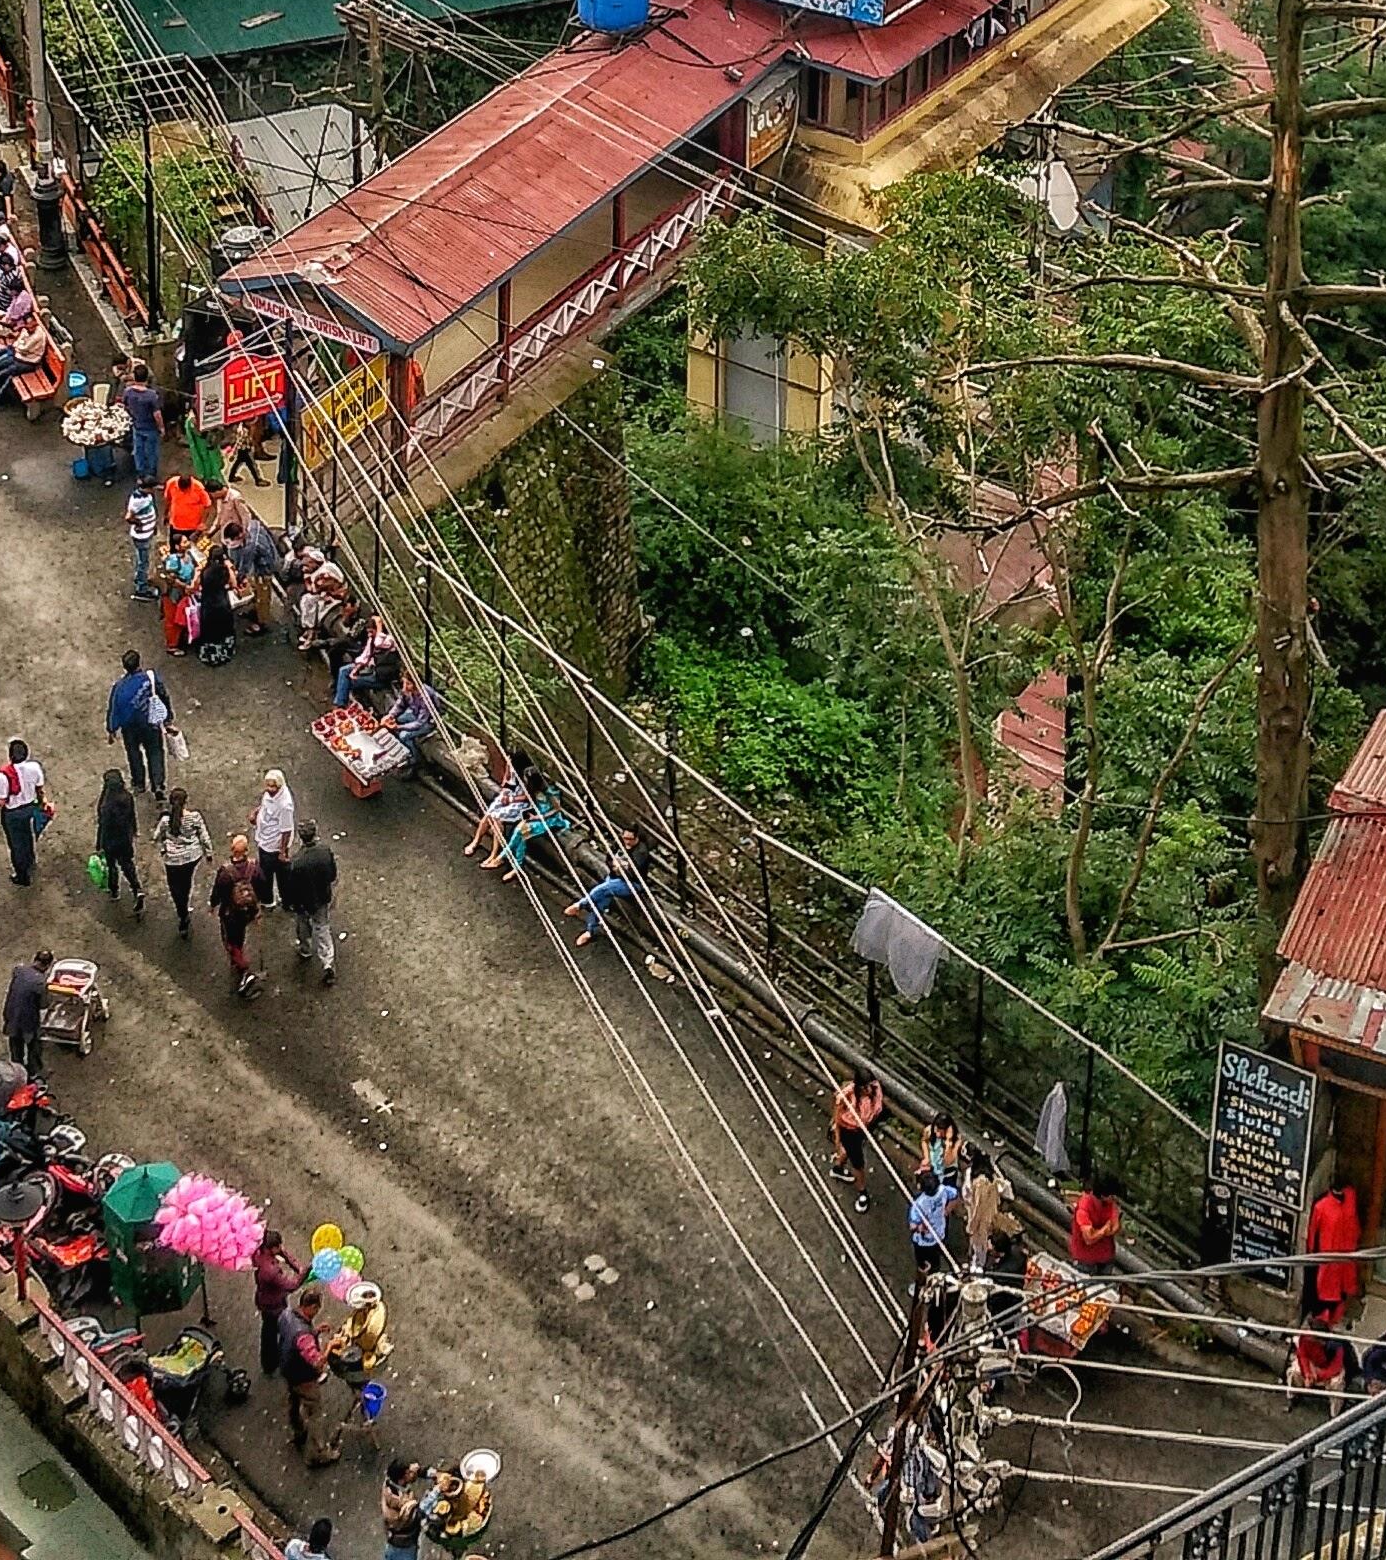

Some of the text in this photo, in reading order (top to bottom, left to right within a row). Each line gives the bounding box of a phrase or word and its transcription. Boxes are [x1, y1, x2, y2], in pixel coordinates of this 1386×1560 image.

[353, 333, 373, 349] LIFT
[229, 368, 281, 405] LIFT
[1221, 1052, 1311, 1110] Shehzadi
[1229, 1095, 1287, 1126] Shawls
[1215, 1129, 1292, 1166] Materials
[1229, 1148, 1283, 1176] Salwar
[1219, 1156, 1274, 1186] Kameez
